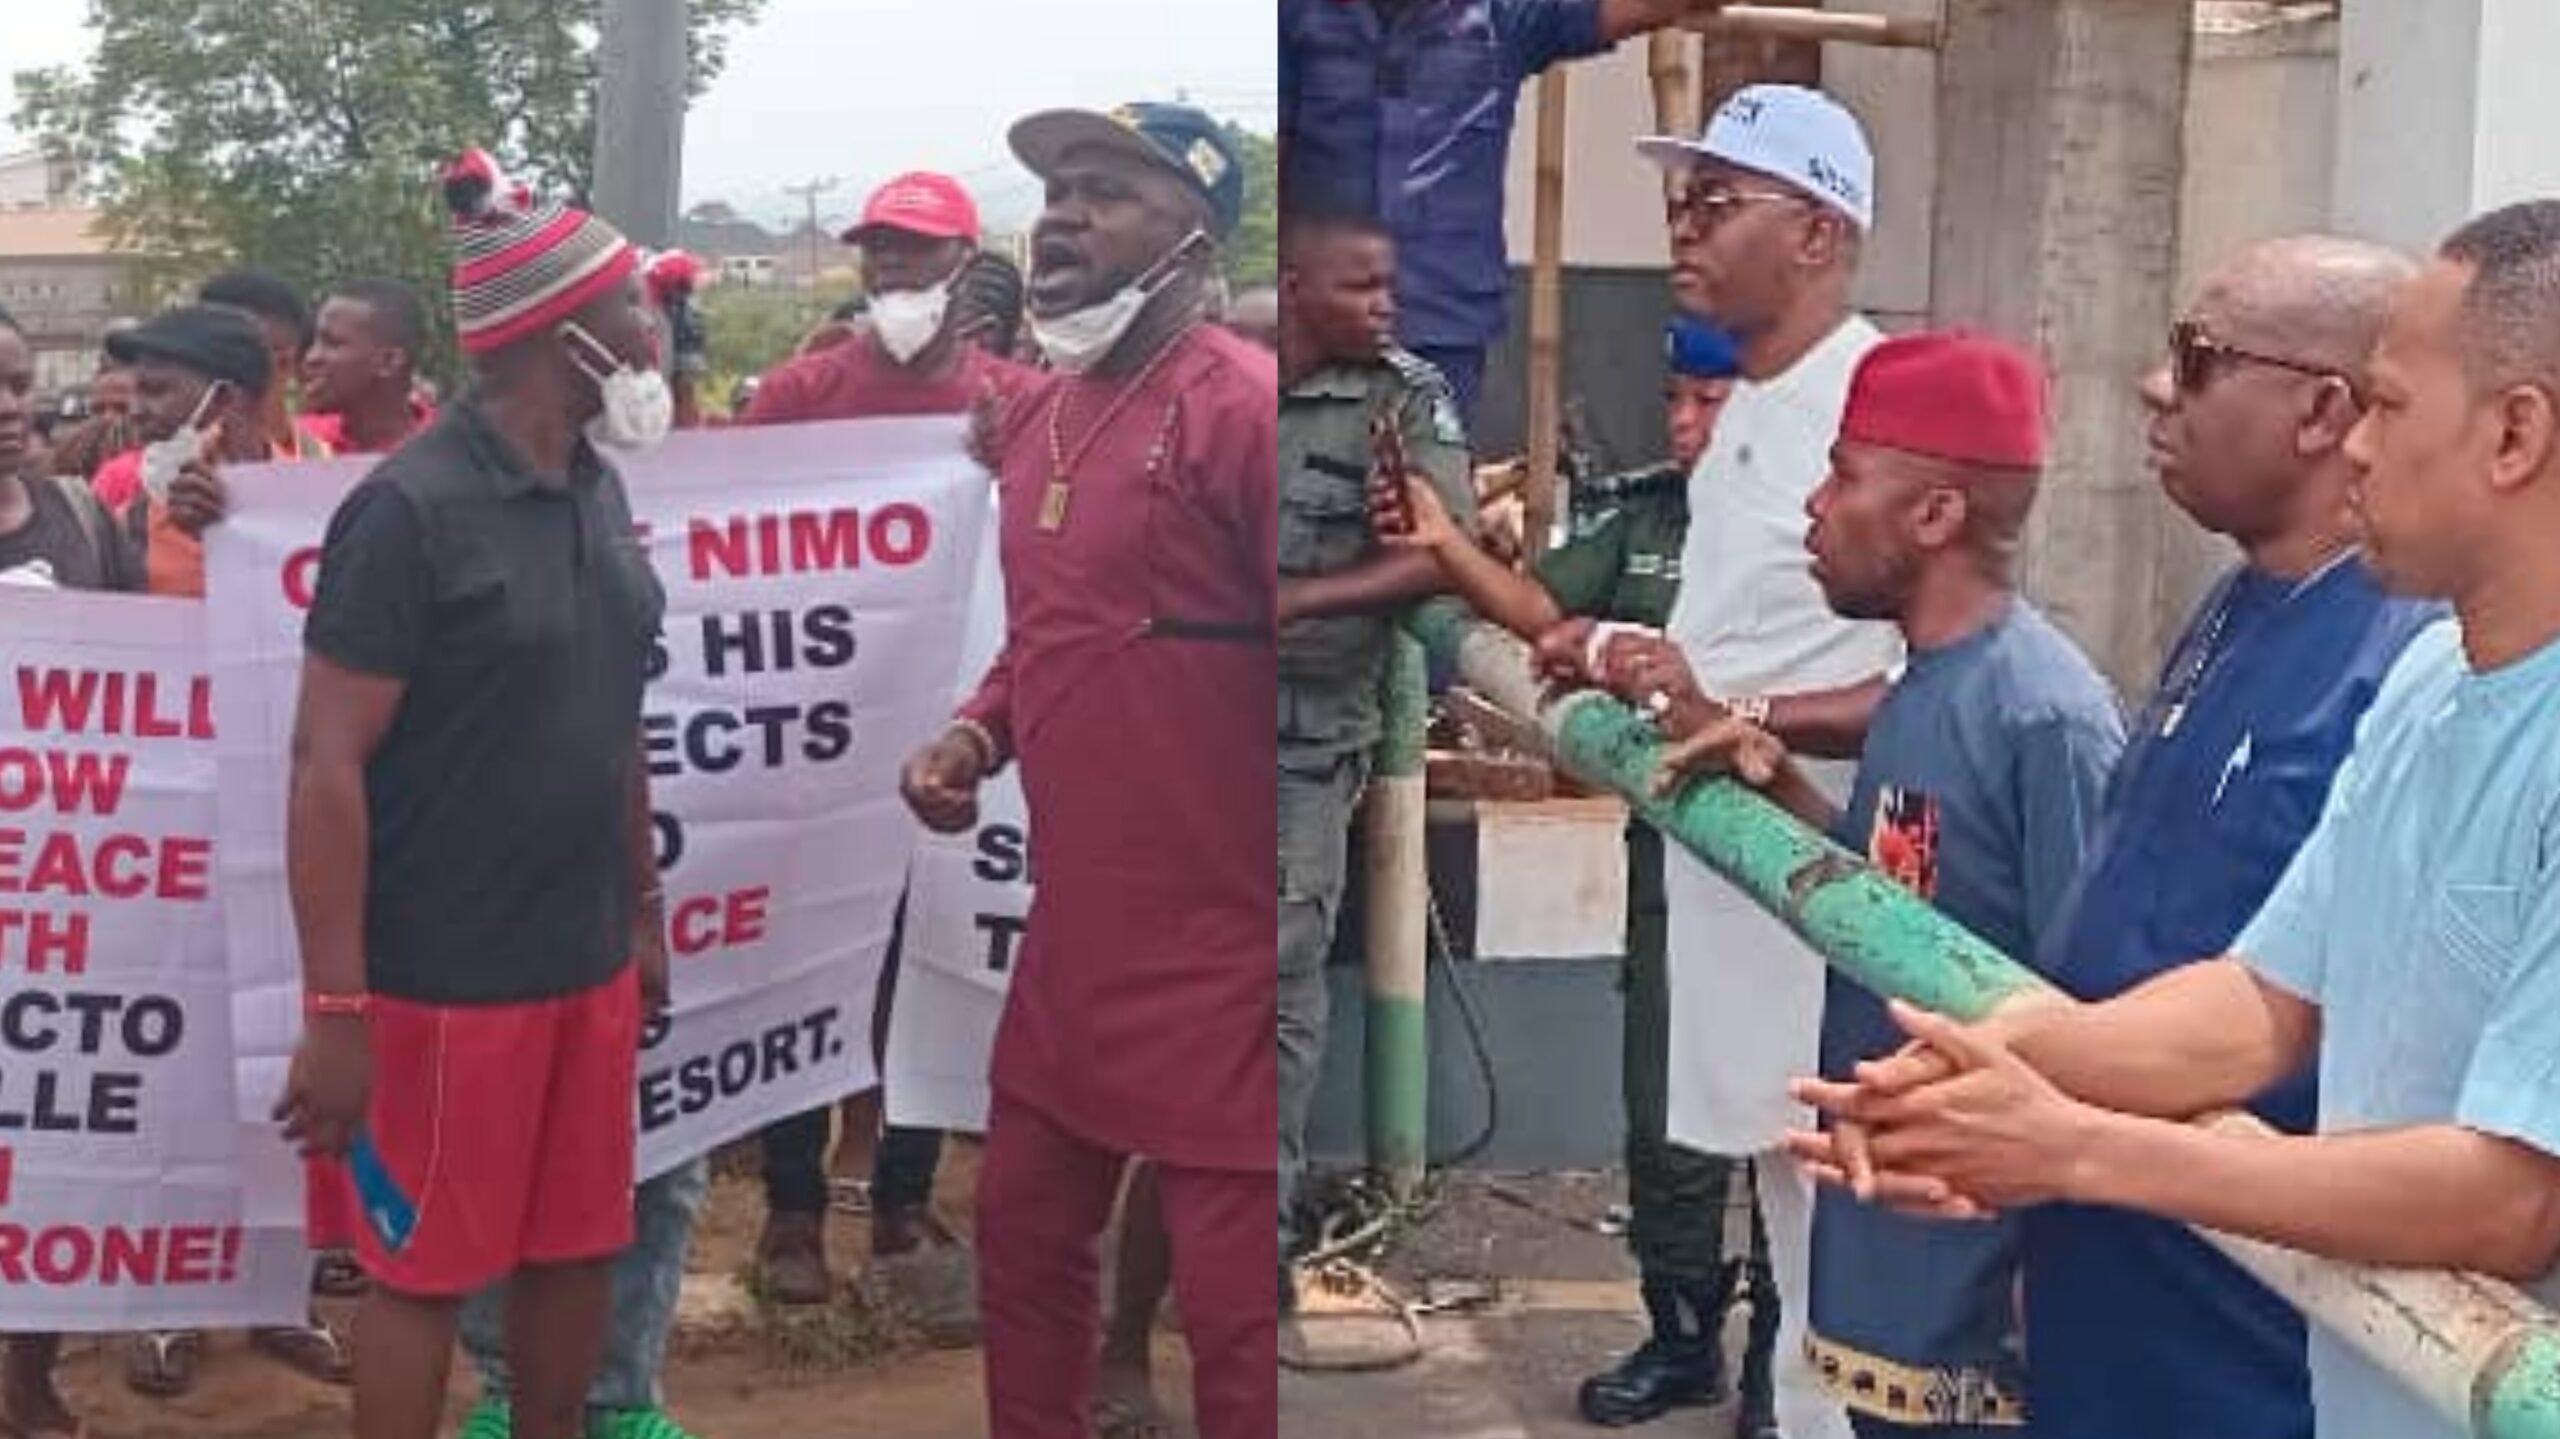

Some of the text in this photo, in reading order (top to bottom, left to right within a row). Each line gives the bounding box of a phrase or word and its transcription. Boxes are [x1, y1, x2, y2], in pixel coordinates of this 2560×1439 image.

[687, 503, 931, 580] NIMO
[702, 605, 856, 676] HIS
[17, 665, 216, 739] WILL
[642, 702, 852, 775] ECTS
[0, 747, 129, 815] OW
[671, 885, 769, 955] CE
[1, 989, 183, 1056] CTO
[639, 1009, 842, 1131] ESORT.
